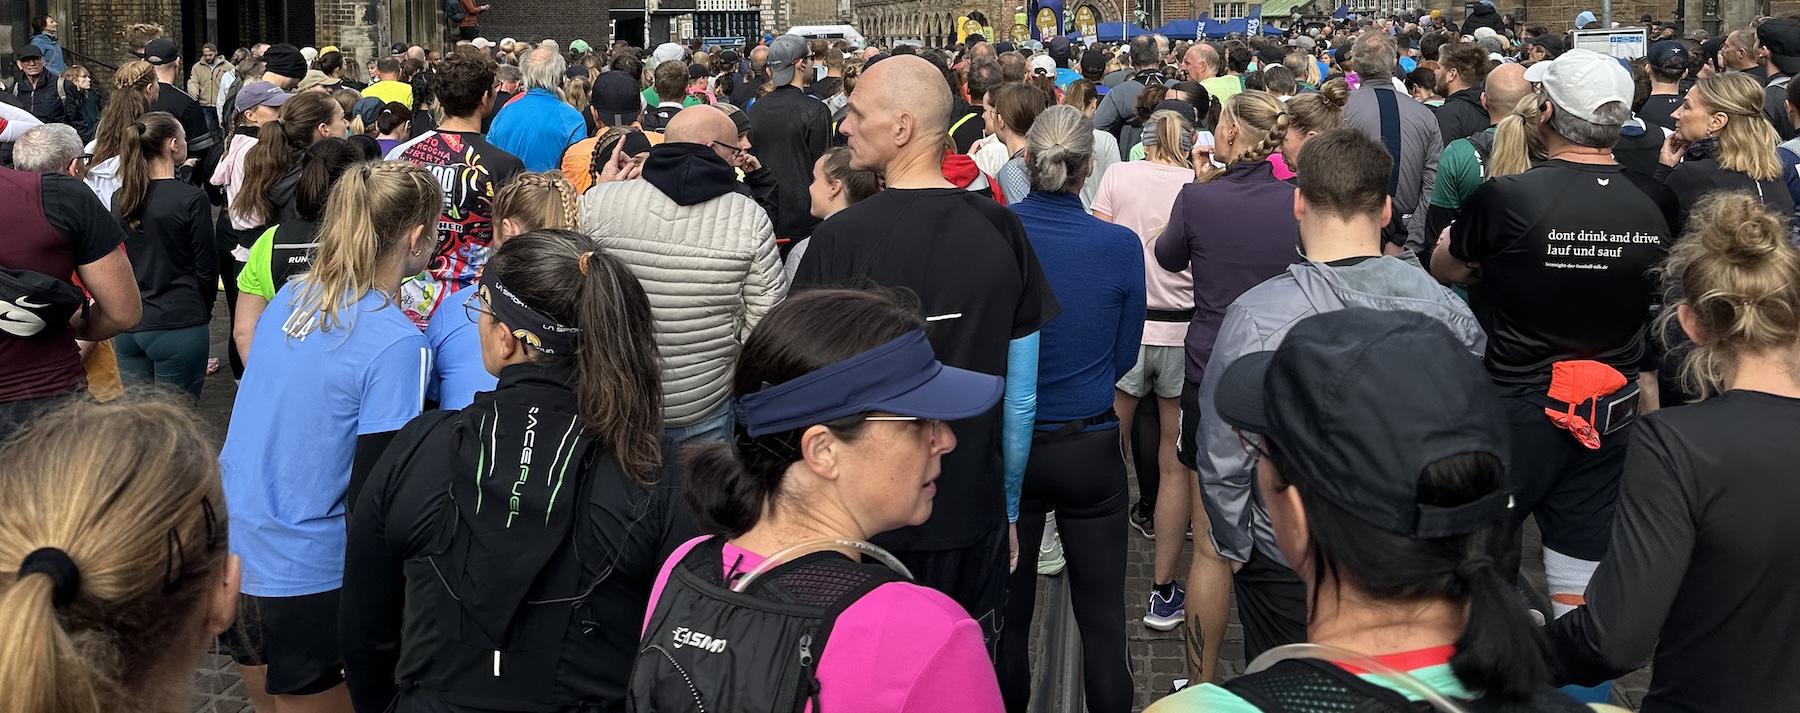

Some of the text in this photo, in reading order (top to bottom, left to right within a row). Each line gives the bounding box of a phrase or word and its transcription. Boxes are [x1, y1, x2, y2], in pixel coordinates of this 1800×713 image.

[1548, 229, 1660, 245] dont drink and drive,
[1547, 244, 1622, 257] lauf und sauf
